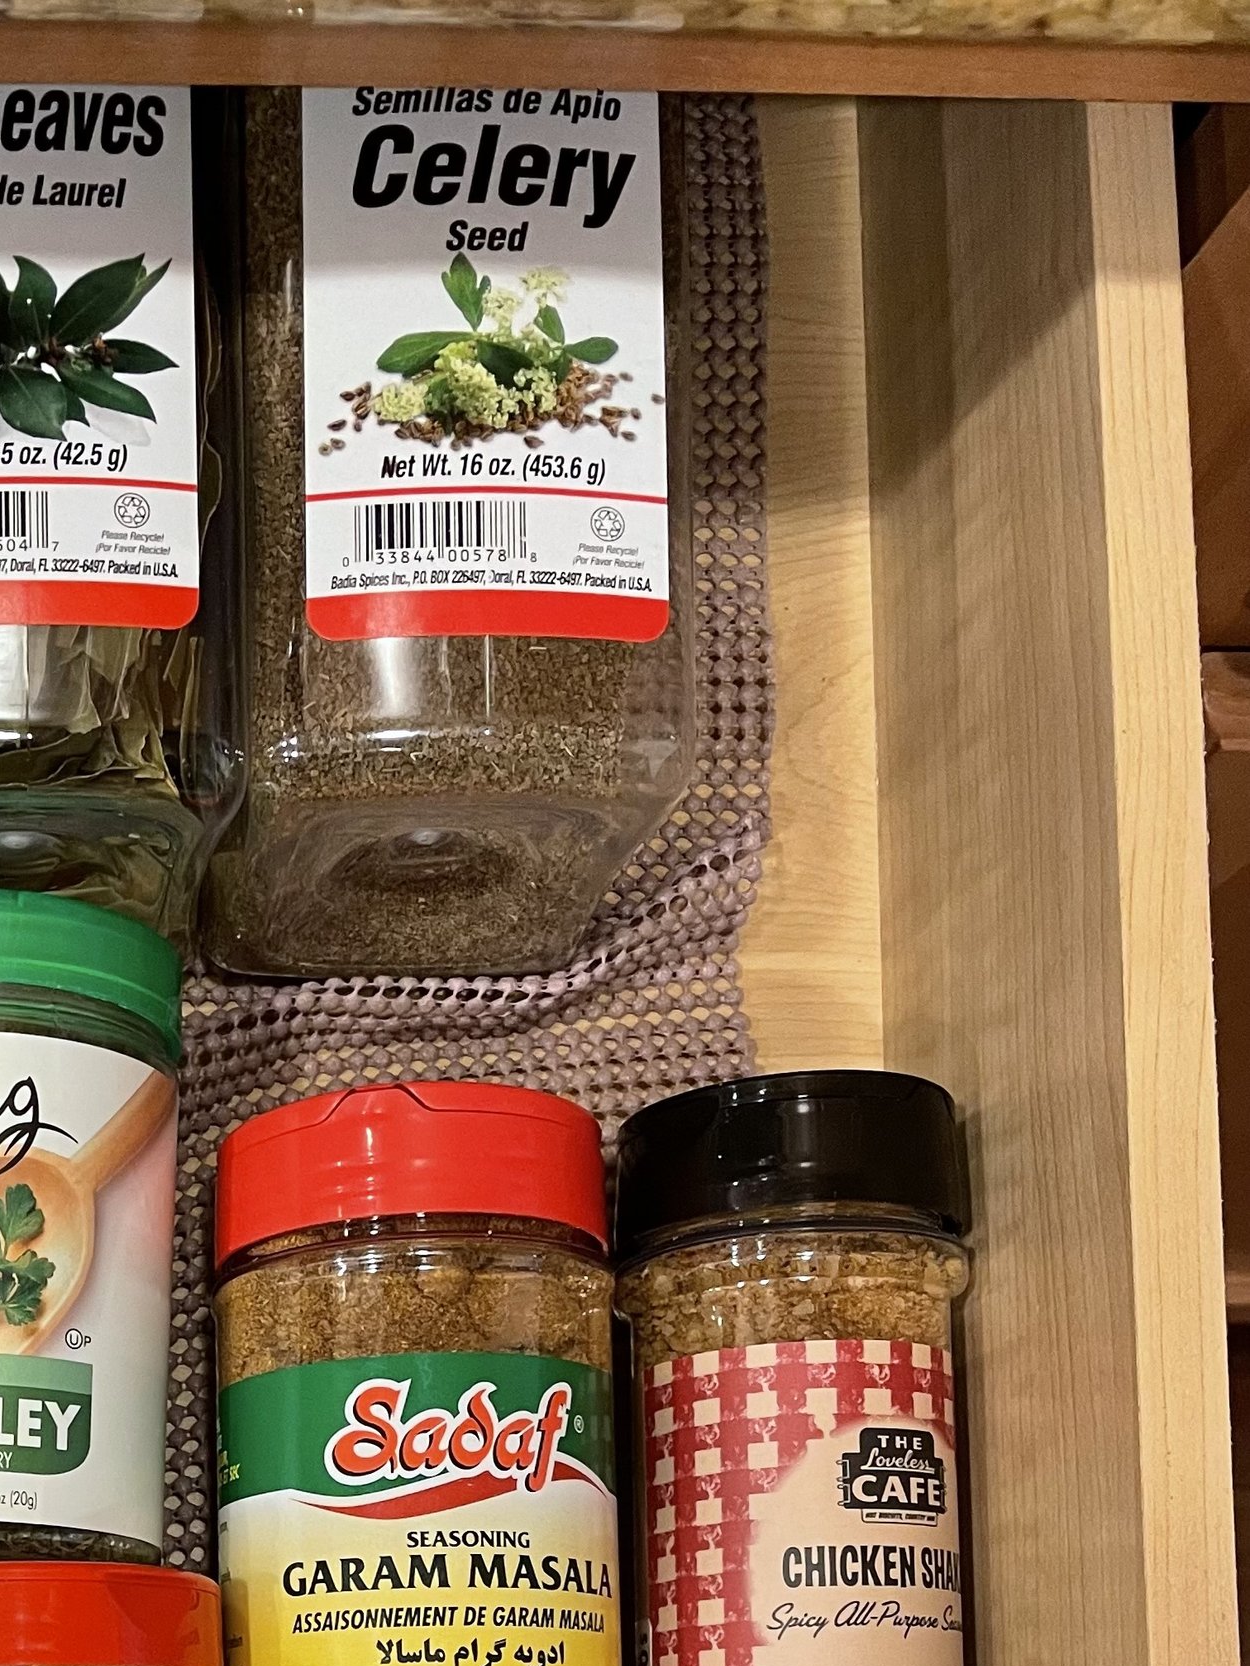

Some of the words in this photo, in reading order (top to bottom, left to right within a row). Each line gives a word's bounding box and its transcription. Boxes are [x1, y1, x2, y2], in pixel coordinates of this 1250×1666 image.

[352, 86, 494, 116] Semillas
[503, 88, 542, 114] de
[550, 88, 621, 123] Apio
[352, 125, 636, 228] Celery
[33, 177, 126, 208] Laurel
[446, 220, 529, 251] Seed
[19, 447, 47, 466] oz.
[53, 442, 104, 469] (42.5
[107, 445, 128, 473] g)
[330, 1383, 572, 1492] Sadaf
[877, 1435, 922, 1450] THE
[865, 1448, 930, 1469] Loveless
[10, 1490, 38, 1510] (20g)
[852, 1475, 940, 1506] CAFE
[407, 1531, 531, 1549] SEASONING
[283, 1554, 450, 1597] GARAM
[470, 1554, 611, 1598] MASALA
[783, 1545, 915, 1588] CHICKEN
[292, 1607, 456, 1634] ASSAISONNEMENT
[464, 1607, 485, 1627] DE
[492, 1608, 554, 1629] GARAM
[559, 1610, 604, 1633] MASALA
[766, 1603, 829, 1640] Spicy
[834, 1600, 938, 1639] All-Purpose
